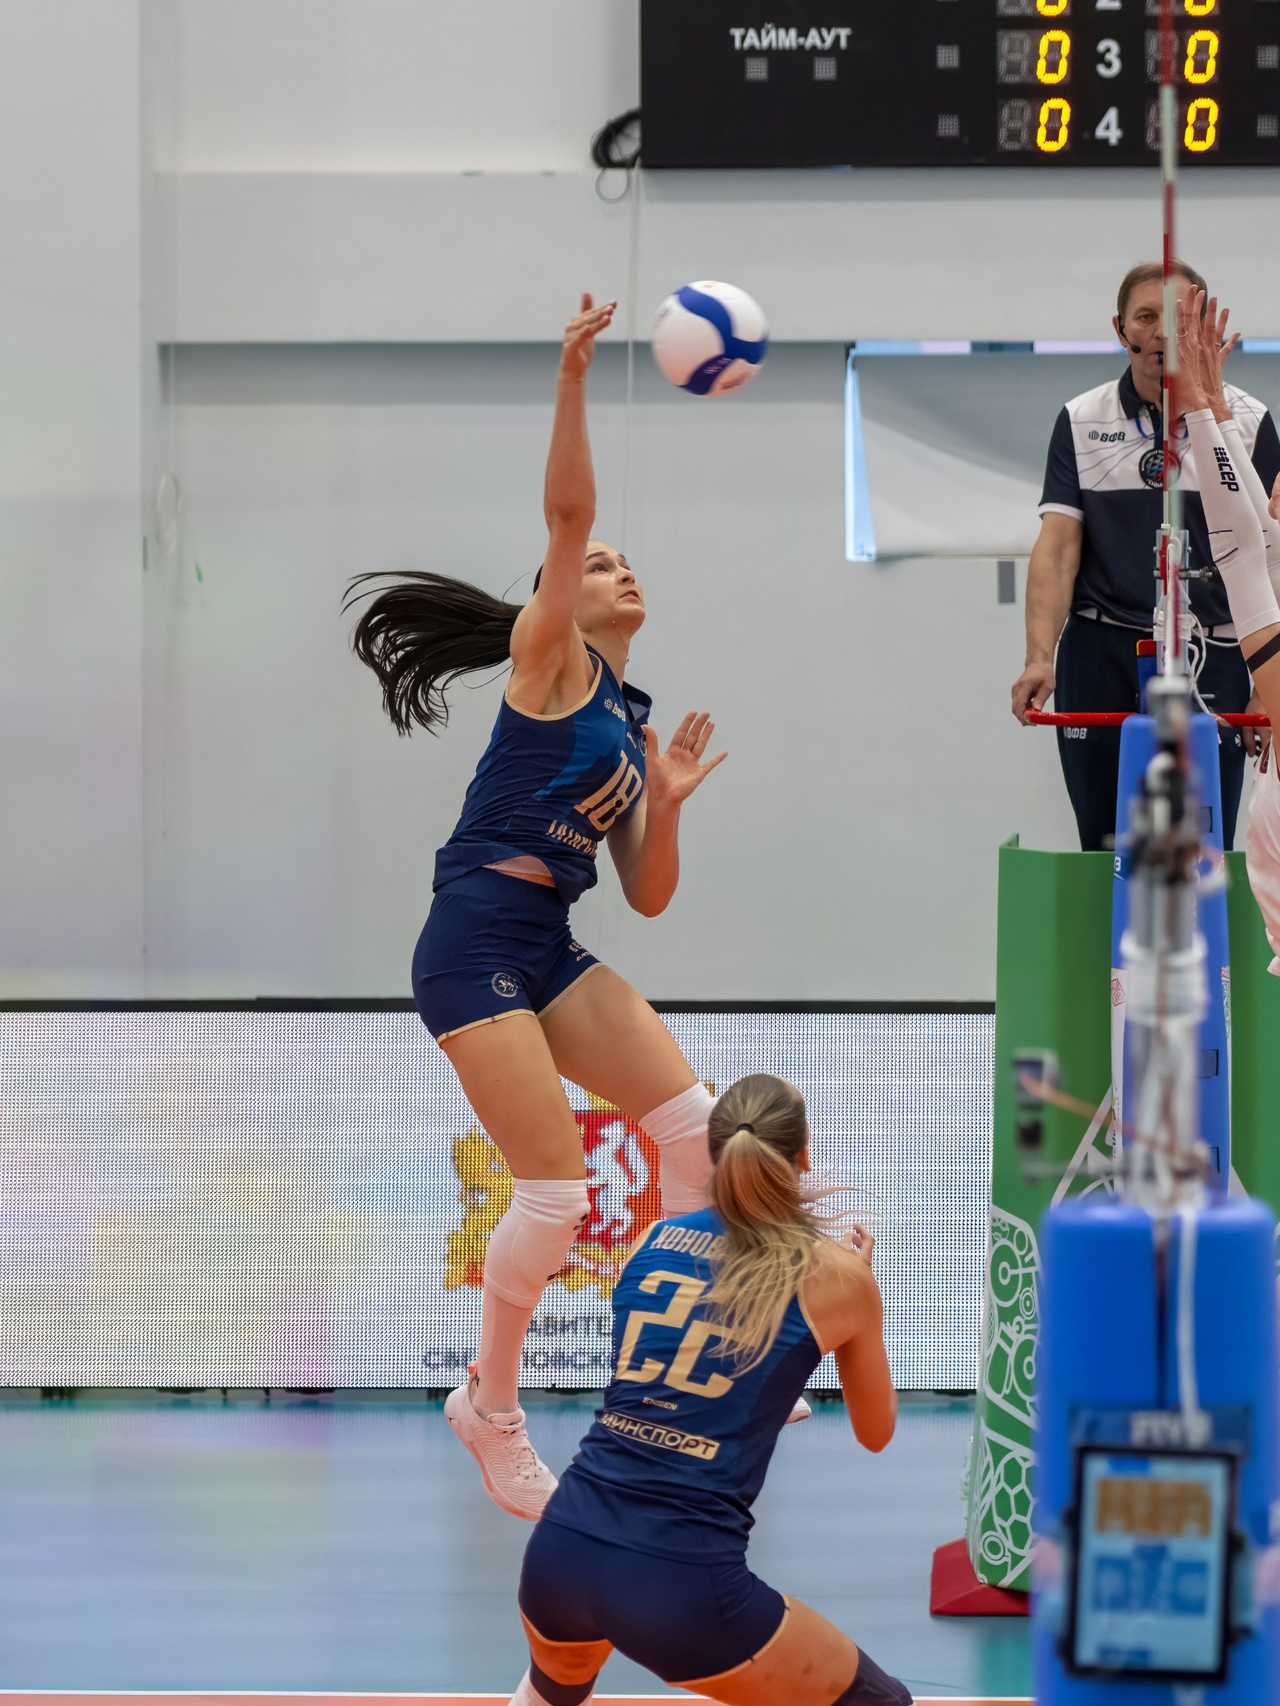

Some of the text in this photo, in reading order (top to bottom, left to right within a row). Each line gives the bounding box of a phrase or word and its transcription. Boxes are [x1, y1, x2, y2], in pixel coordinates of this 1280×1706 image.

[729, 22, 853, 50] ТАЙМ-АУТ
[1036, 29, 1219, 84] 0 3 0
[1036, 97, 1219, 152] 0 4 0
[574, 750, 643, 832] 18
